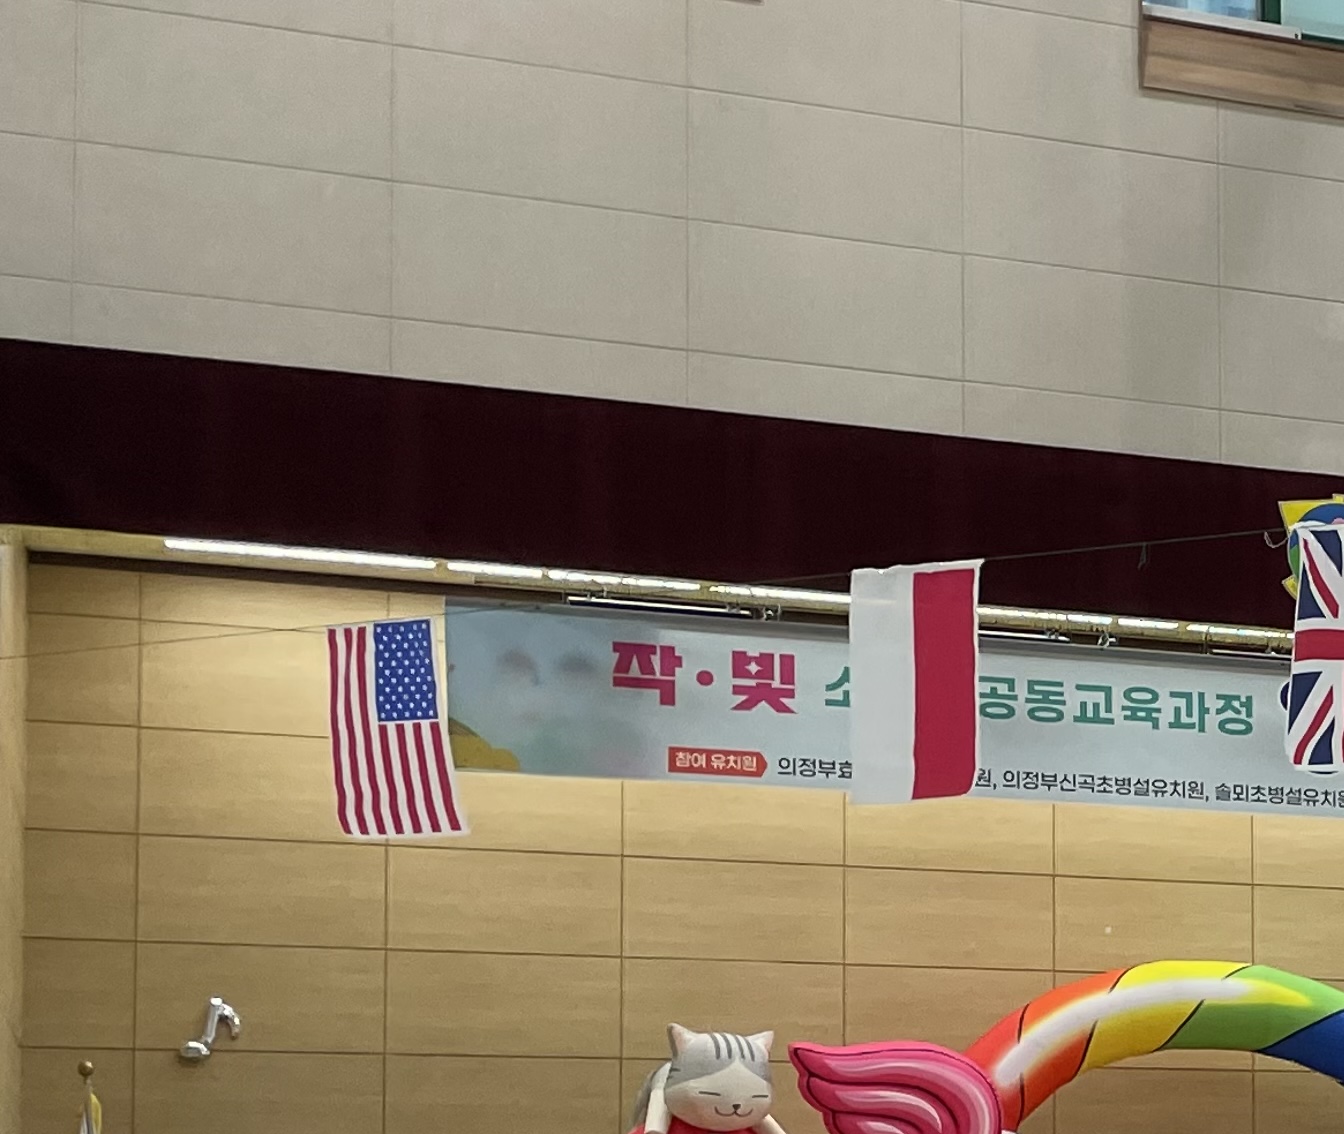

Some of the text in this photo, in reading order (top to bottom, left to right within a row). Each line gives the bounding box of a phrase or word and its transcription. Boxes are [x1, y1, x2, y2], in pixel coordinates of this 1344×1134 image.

[675, 752, 757, 772] 참여 유치원
[1002, 769, 1209, 803] 의정부신곡초병설유치원,
